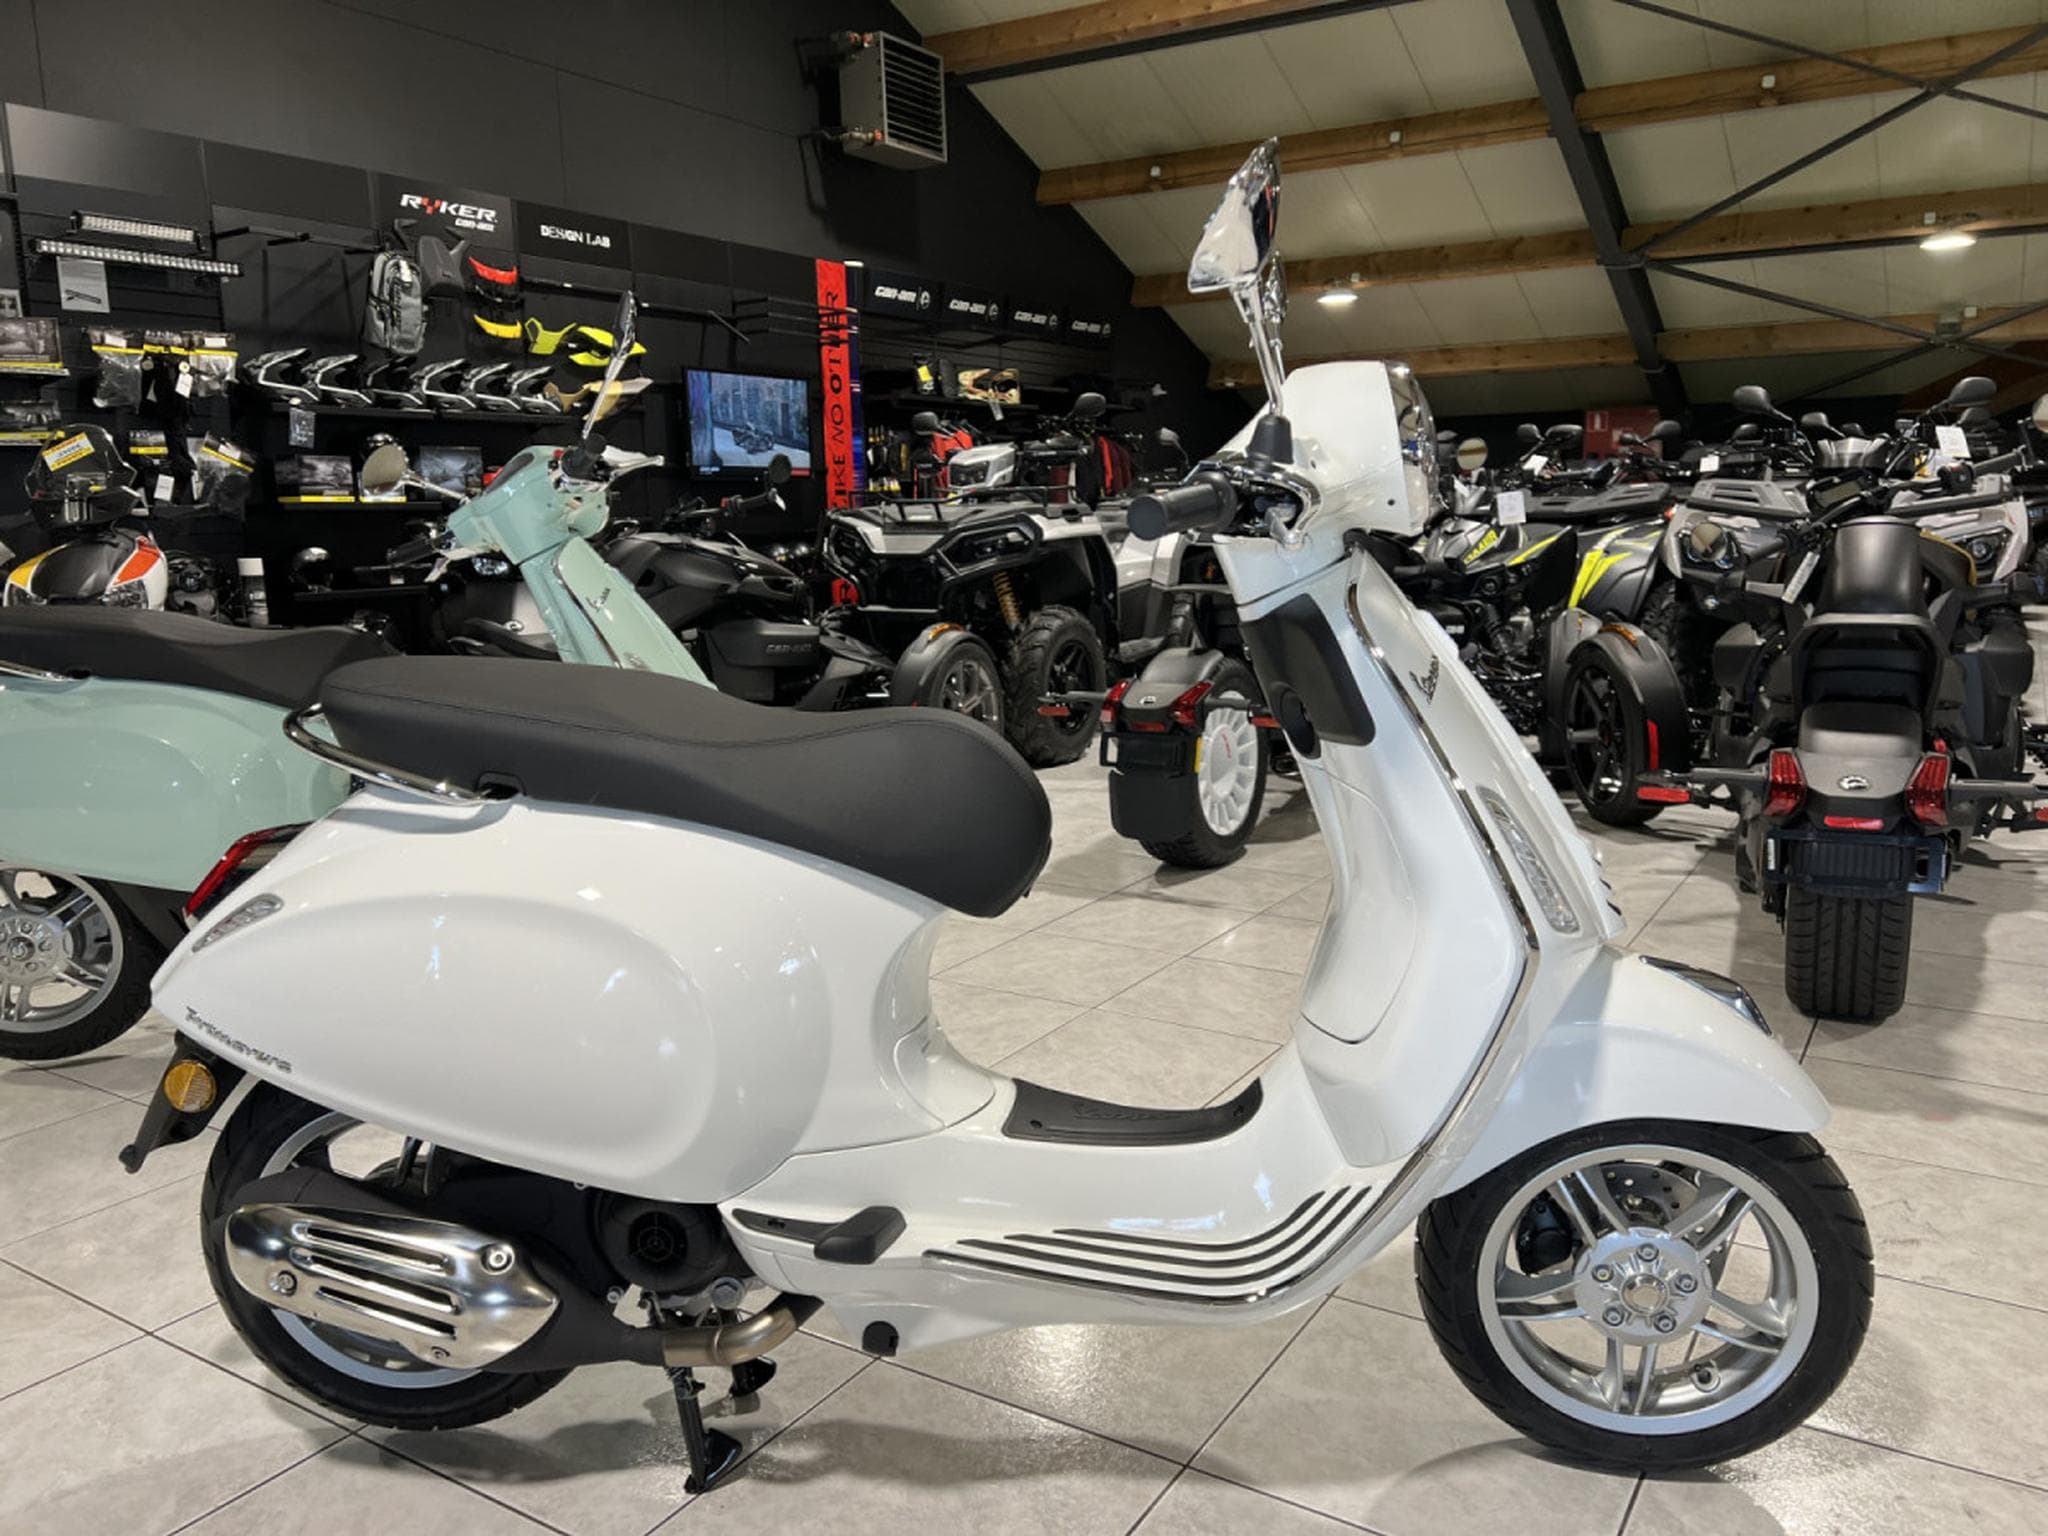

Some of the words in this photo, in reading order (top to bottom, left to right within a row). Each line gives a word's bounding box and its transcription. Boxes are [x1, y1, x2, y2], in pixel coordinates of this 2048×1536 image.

[400, 193, 497, 221] RYKER
[540, 225, 583, 243] DESIGN
[586, 235, 611, 248] LAB
[831, 403, 846, 444] NO
